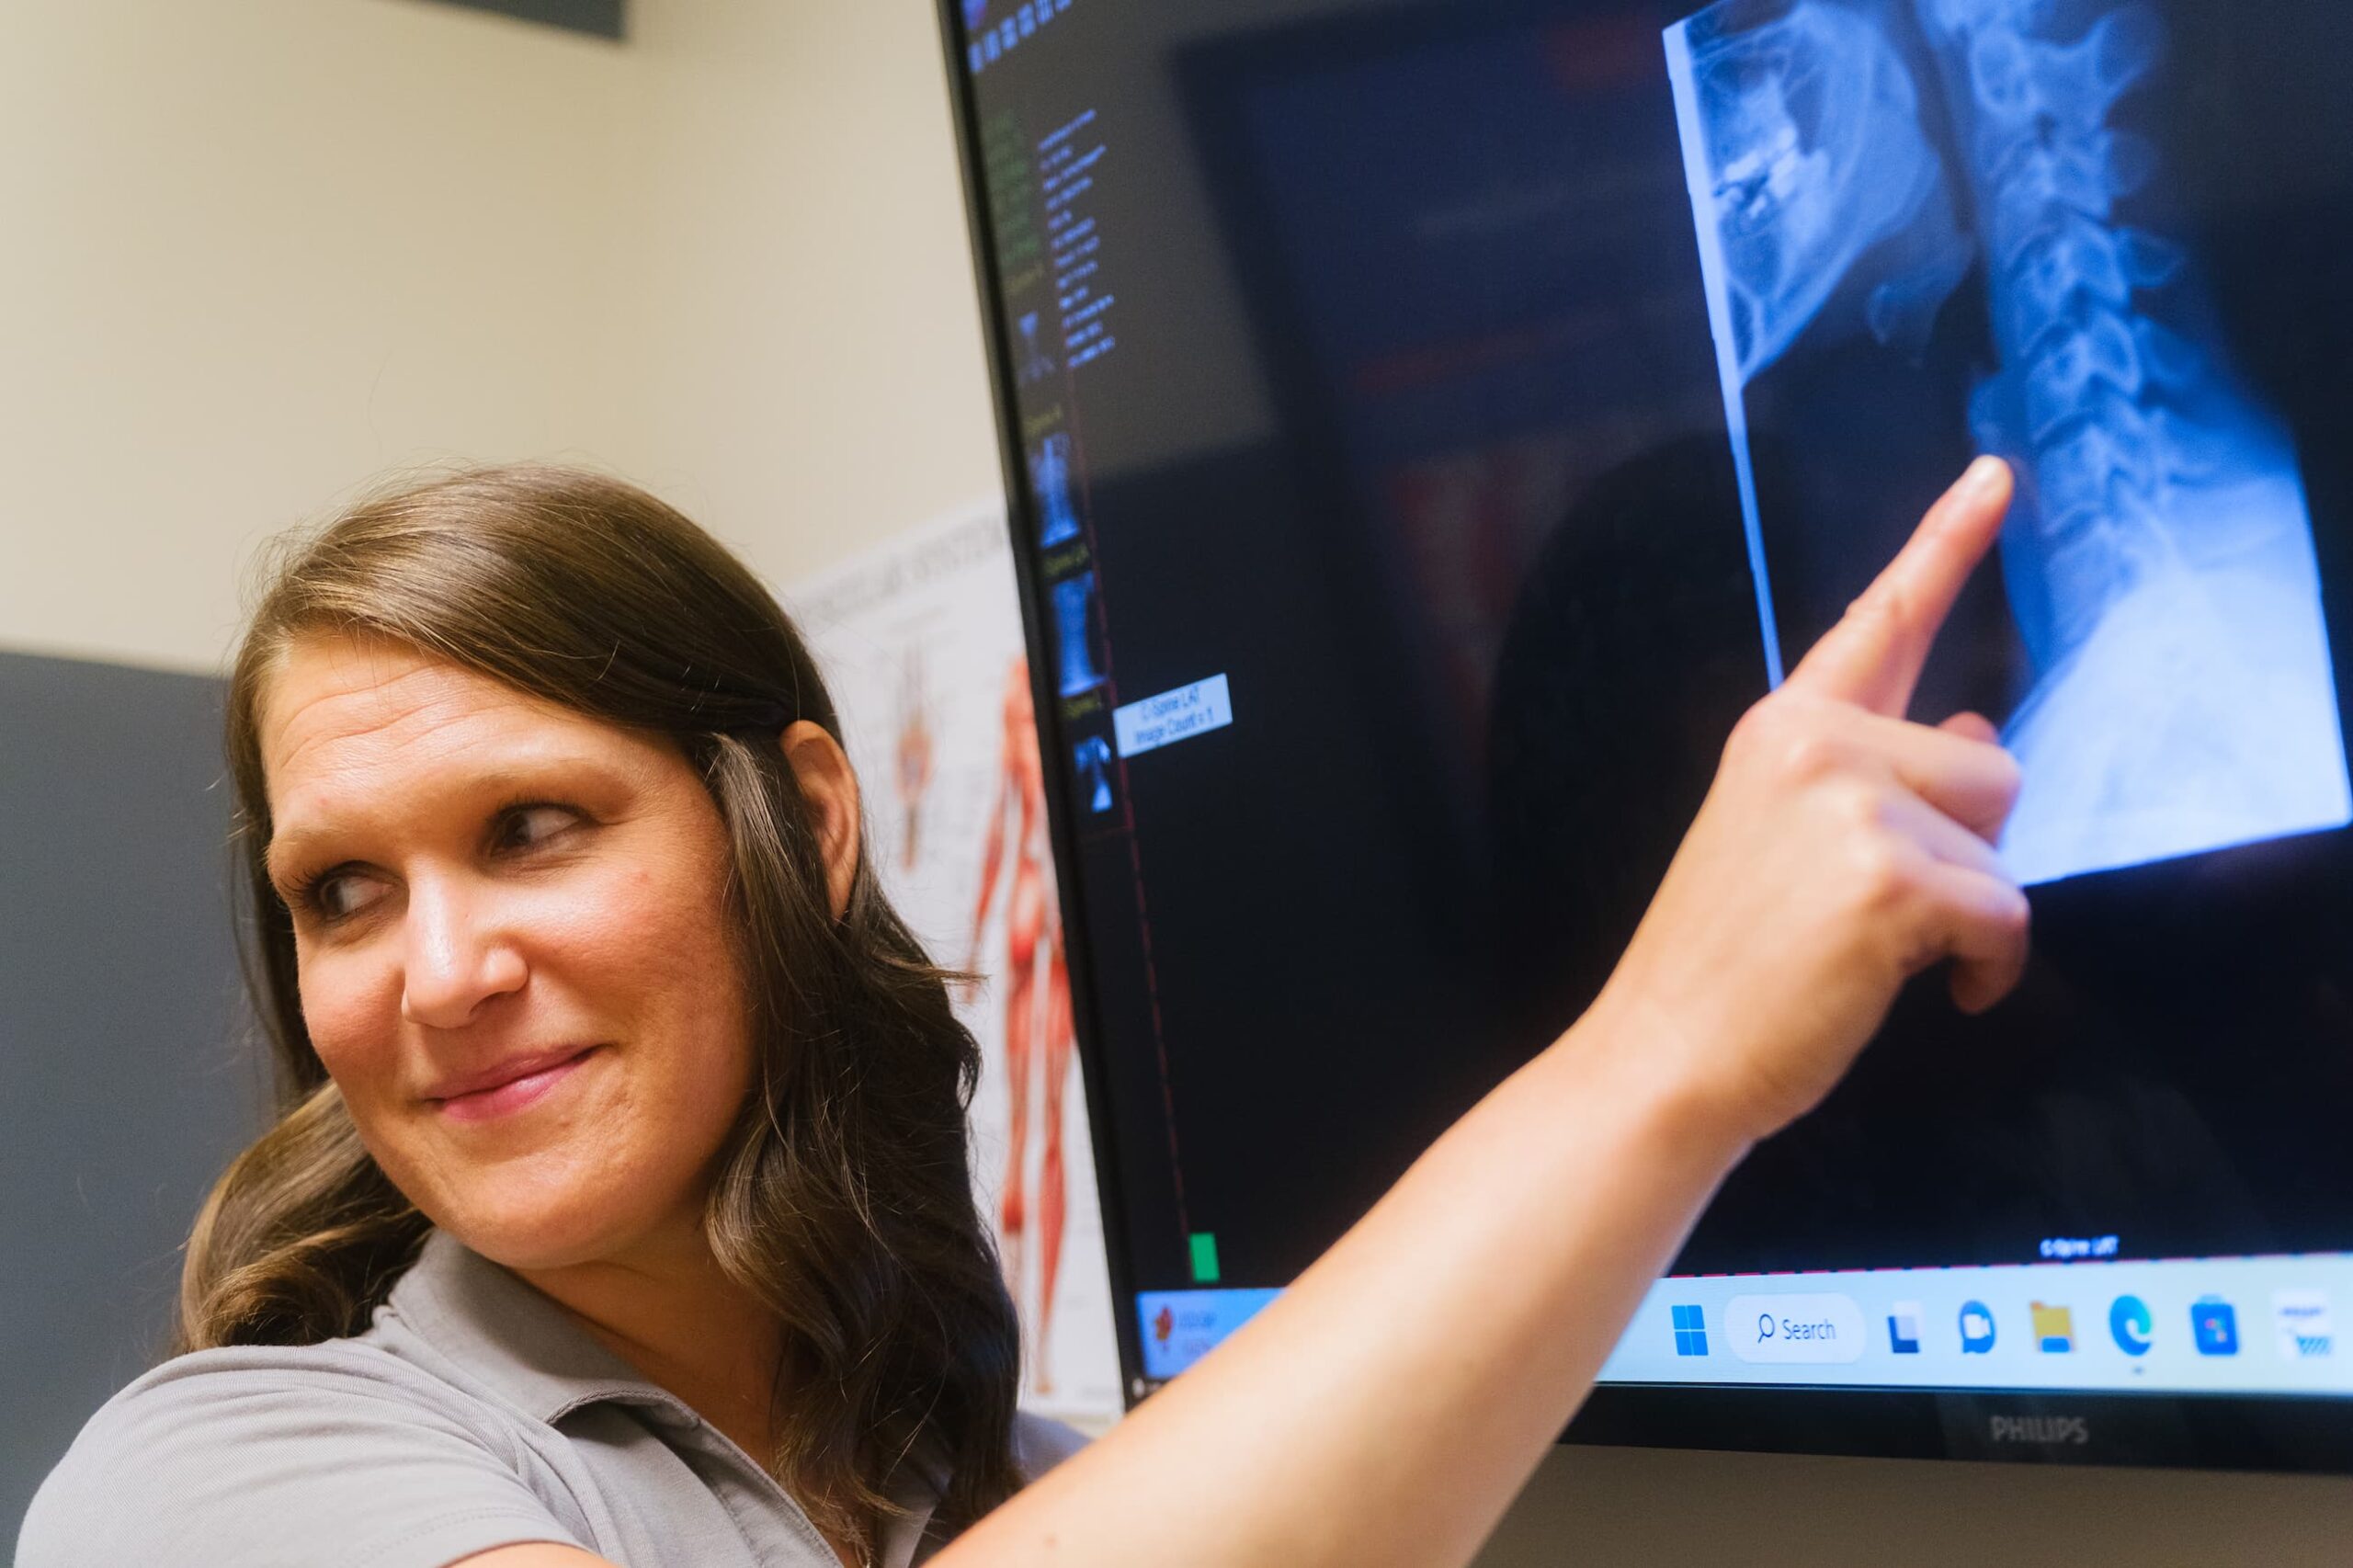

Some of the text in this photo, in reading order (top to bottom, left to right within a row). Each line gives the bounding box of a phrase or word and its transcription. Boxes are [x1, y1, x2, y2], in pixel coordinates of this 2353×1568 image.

[1136, 724, 1165, 743] Image
[1167, 711, 1196, 735] Count
[1782, 1318, 1836, 1340] Search
[1990, 1415, 2089, 1444] PHILIPS
